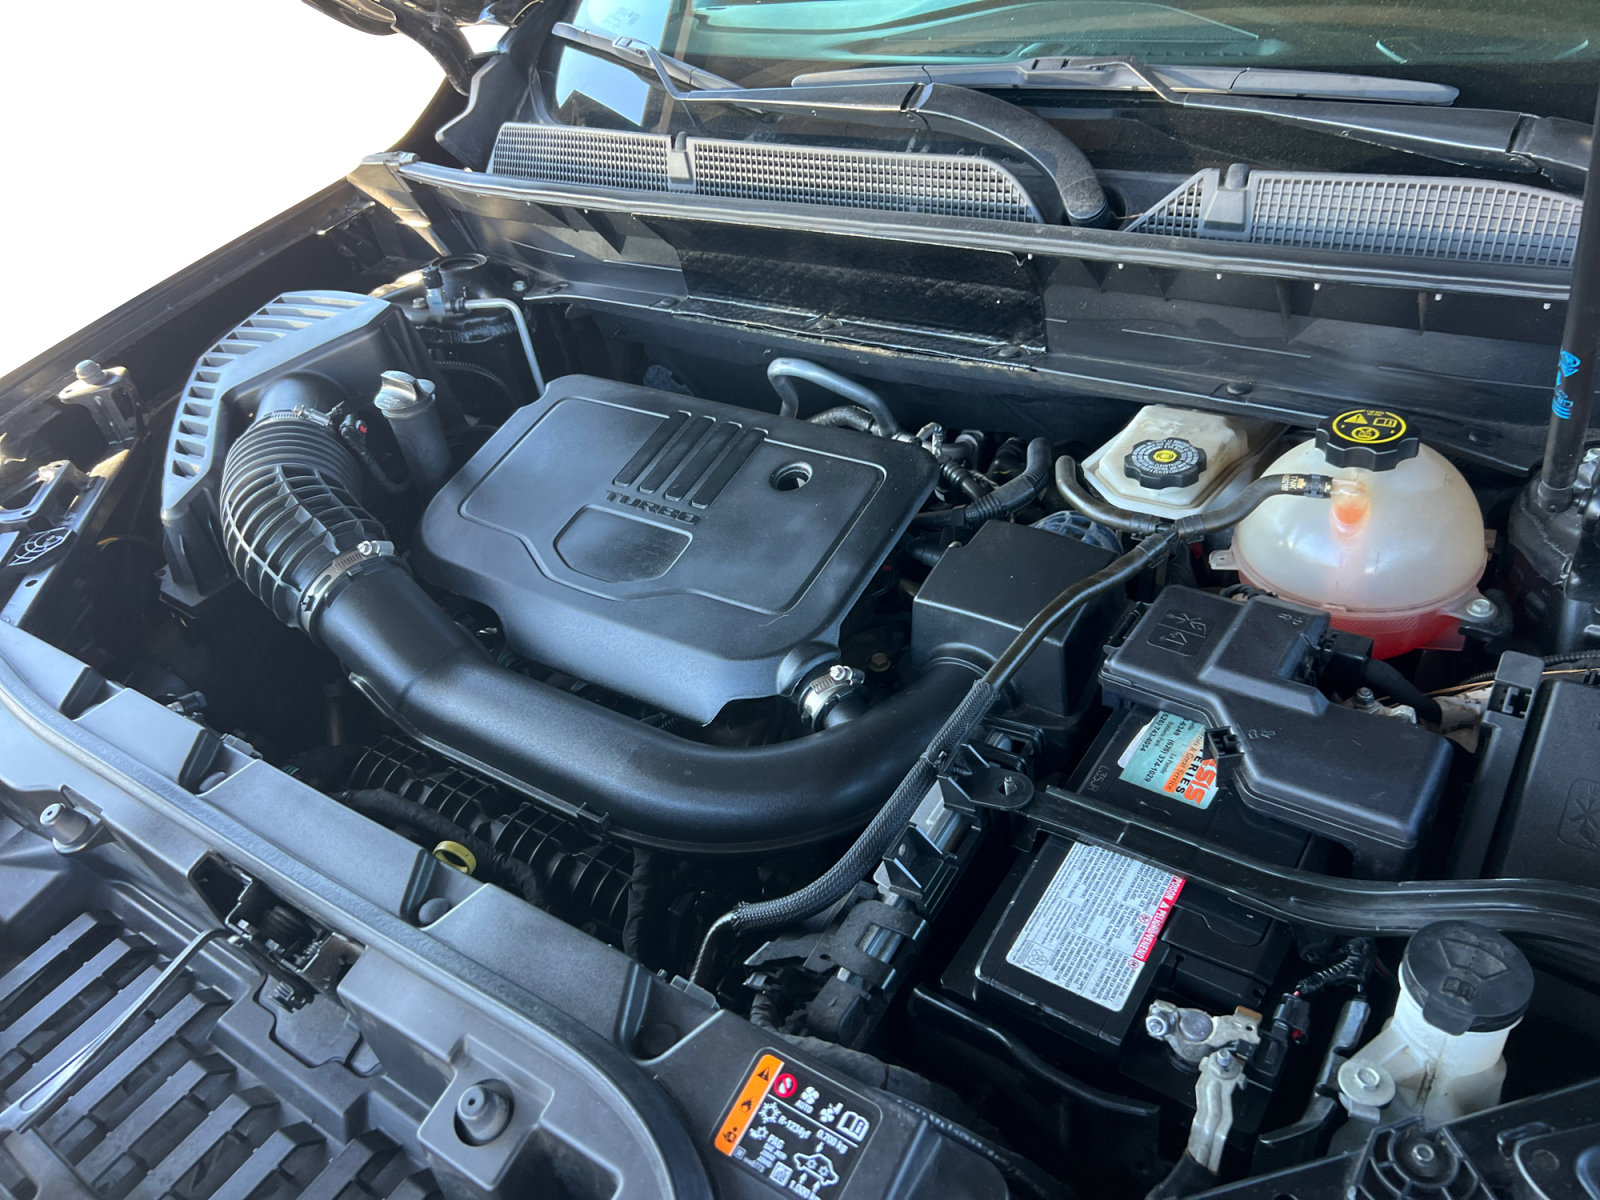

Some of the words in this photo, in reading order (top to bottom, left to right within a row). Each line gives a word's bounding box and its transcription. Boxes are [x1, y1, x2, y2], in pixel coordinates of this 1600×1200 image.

[606, 490, 701, 525] TURBO
[1138, 725, 1160, 752] 743-4054
[1142, 754, 1164, 783] 374-1029
[1165, 768, 1183, 790] Service
[793, 1098, 814, 1114] AUTO
[766, 1133, 786, 1151] PAG
[815, 1128, 838, 1147] 0.700
[834, 1140, 849, 1155] kg
